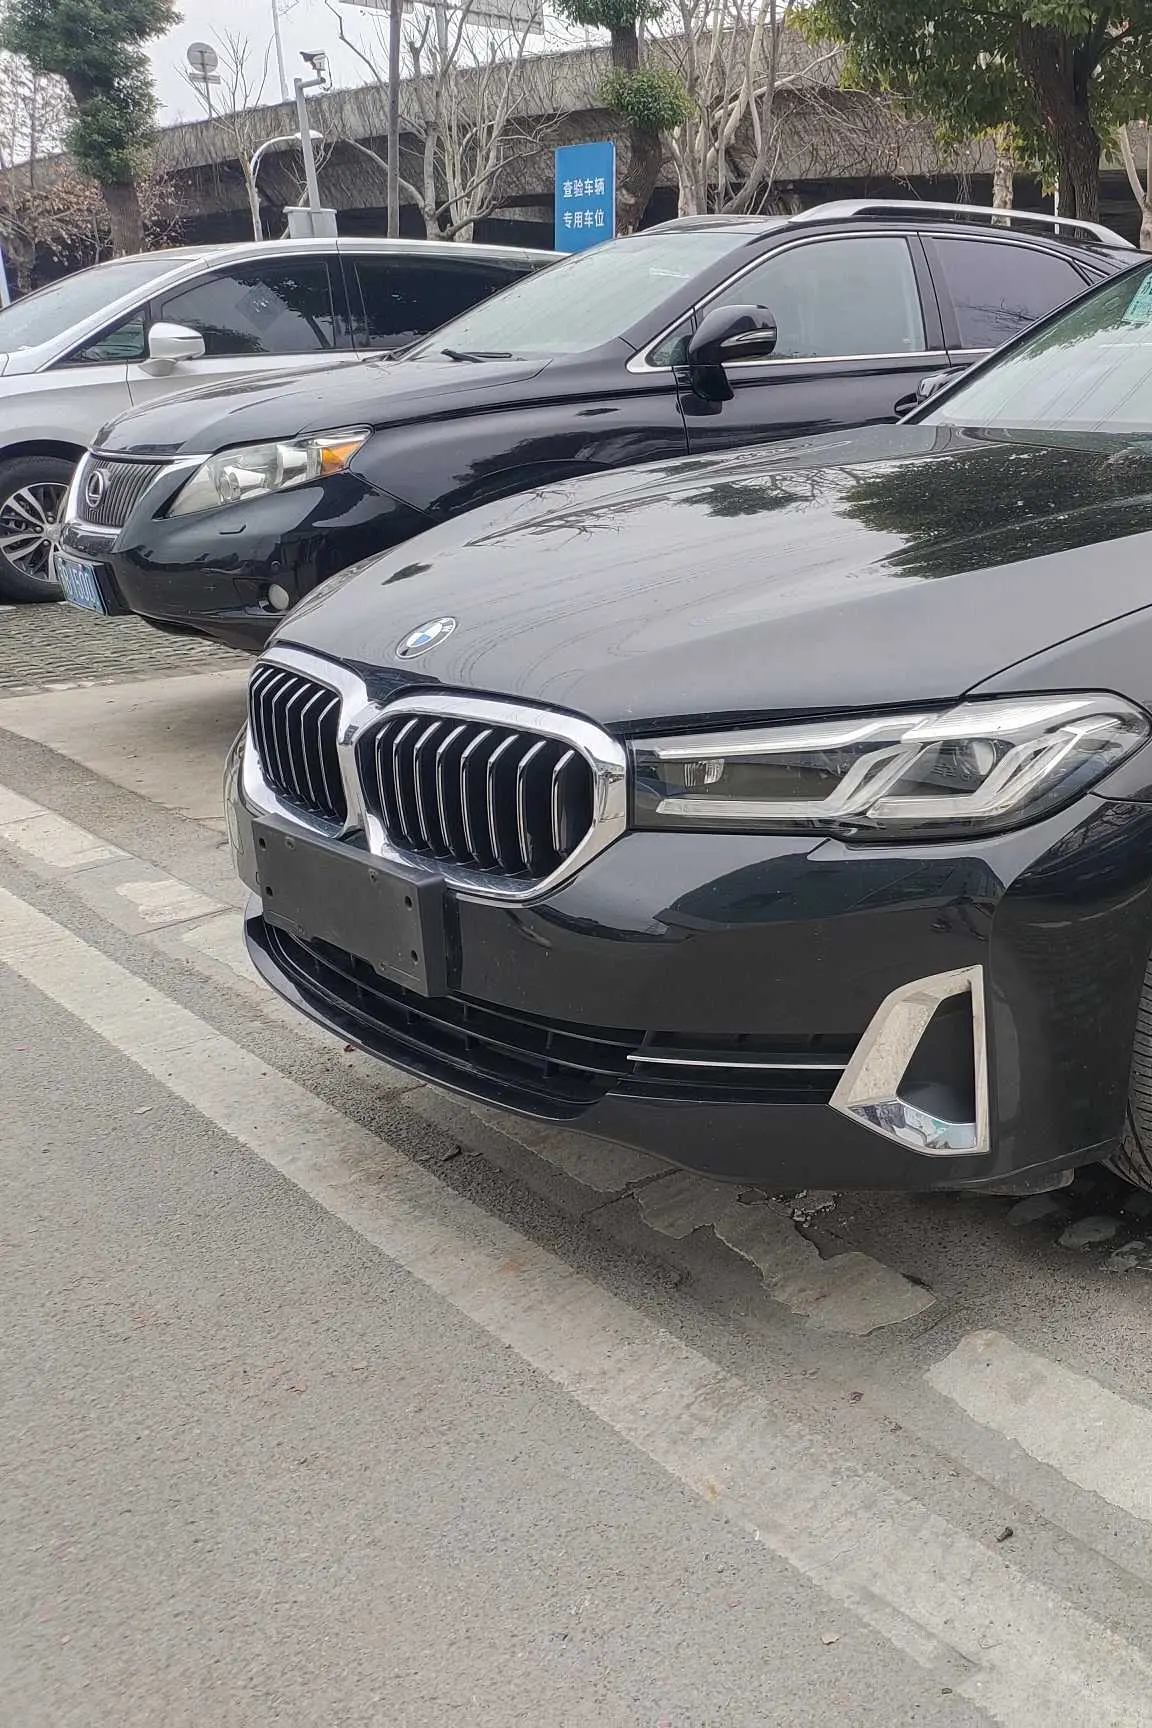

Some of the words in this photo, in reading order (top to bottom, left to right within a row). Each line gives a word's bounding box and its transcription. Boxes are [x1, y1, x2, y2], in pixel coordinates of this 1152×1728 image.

[563, 177, 605, 198] 查验车辆
[563, 209, 605, 229] 专用车位
